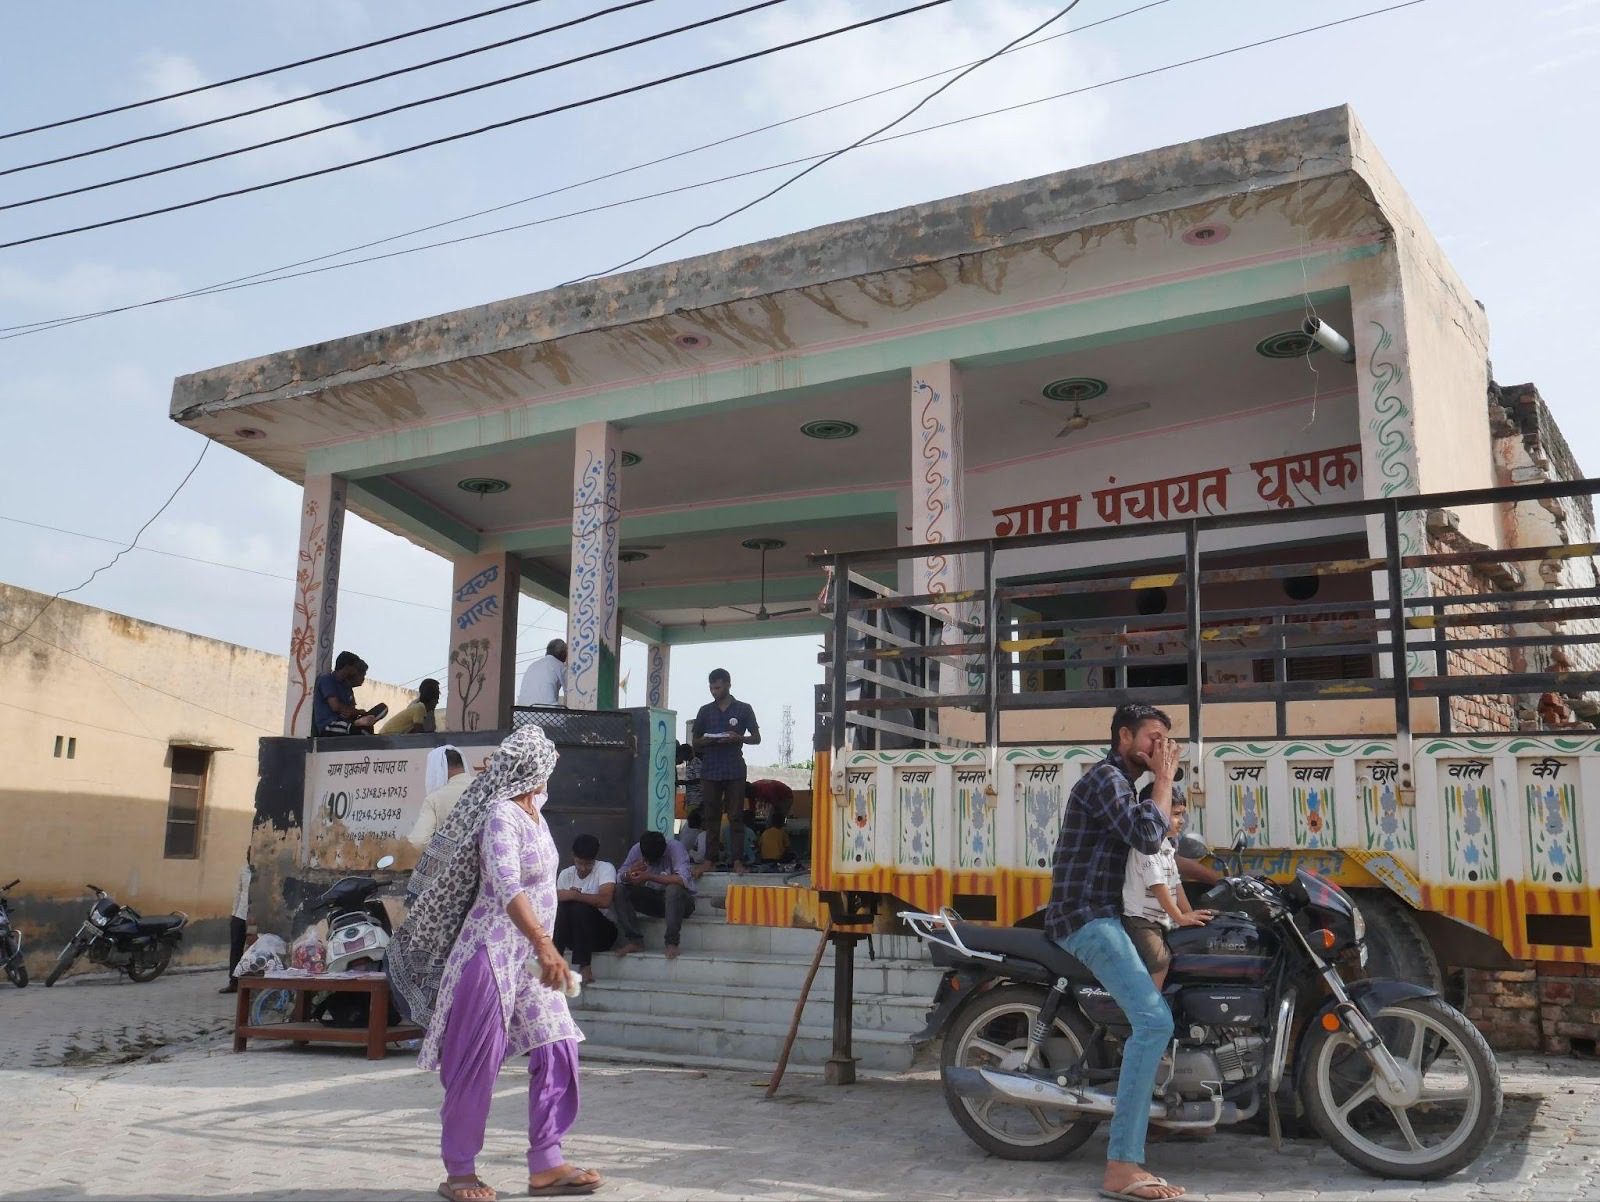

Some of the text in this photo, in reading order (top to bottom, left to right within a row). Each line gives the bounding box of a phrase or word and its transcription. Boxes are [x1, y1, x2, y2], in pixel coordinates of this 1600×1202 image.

[1091, 468, 1232, 525] पंचायत
[454, 565, 499, 602] स्वच्छ
[457, 594, 499, 629] भारत
[901, 771, 932, 784] बाबा
[956, 770, 986, 784] मनस
[1026, 764, 1060, 784] गिरी
[1229, 766, 1264, 781] जय
[1292, 766, 1334, 782] बाबा
[1448, 760, 1489, 781] वाले
[1530, 757, 1568, 780] की
